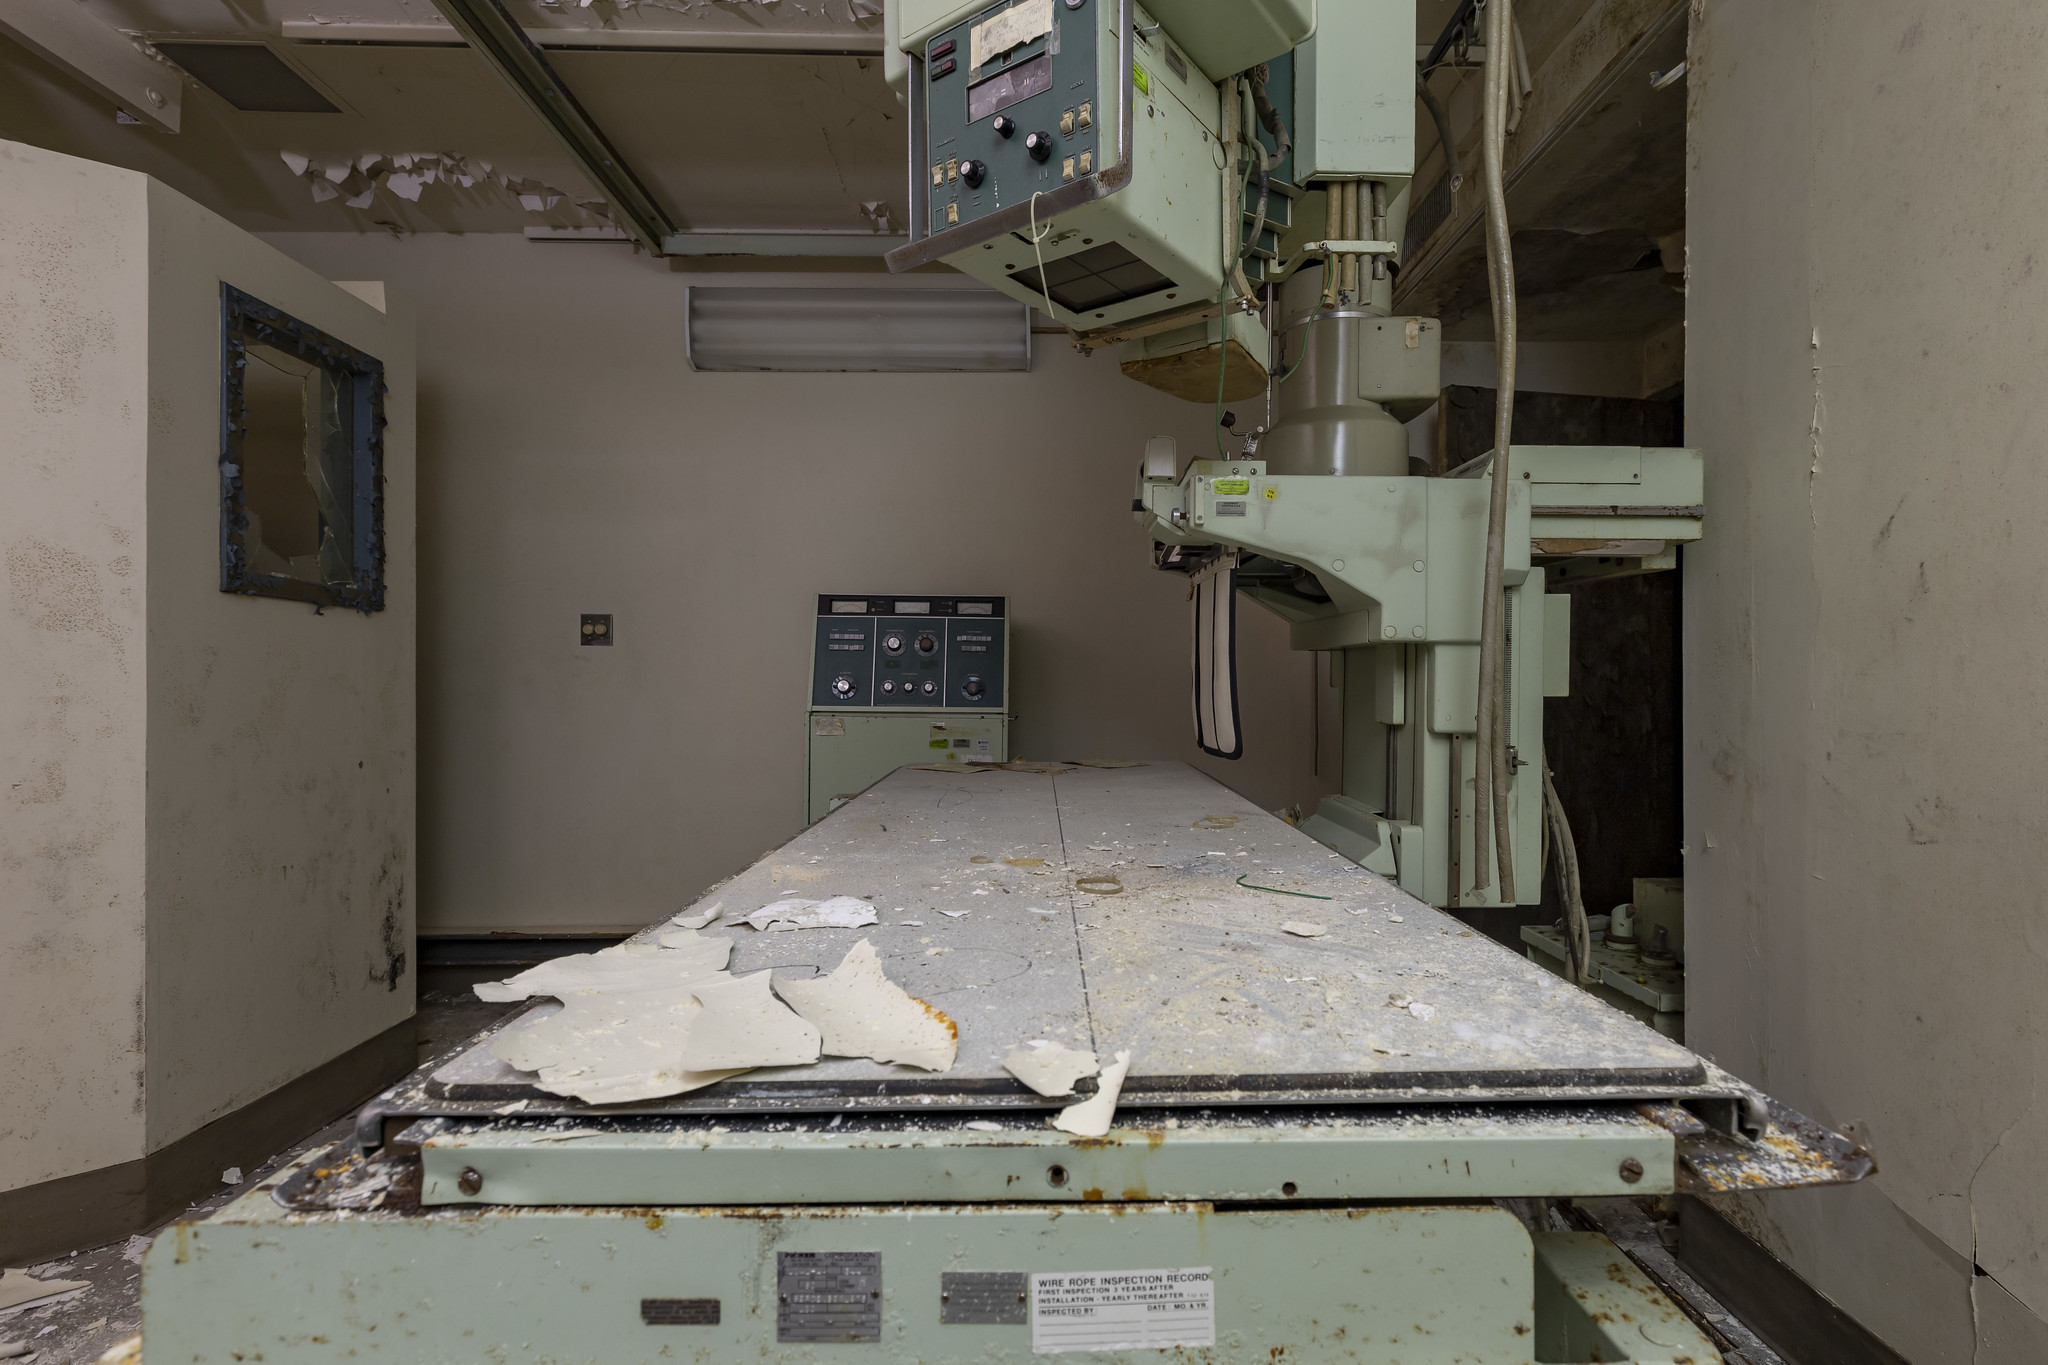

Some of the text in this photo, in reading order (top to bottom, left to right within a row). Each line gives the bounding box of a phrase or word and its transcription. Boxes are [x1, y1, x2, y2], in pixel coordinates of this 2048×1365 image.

[1038, 1272, 1209, 1288] WIRE ROPE INSPECTION RECORD
[1062, 1287, 1110, 1295] INSPECTION
[1121, 1285, 1147, 1293] YEARS
[1038, 1296, 1095, 1305] INSTALLATION
[1133, 1292, 1184, 1301] THEREAFTER
[1038, 1308, 1082, 1316] INSPECTED
